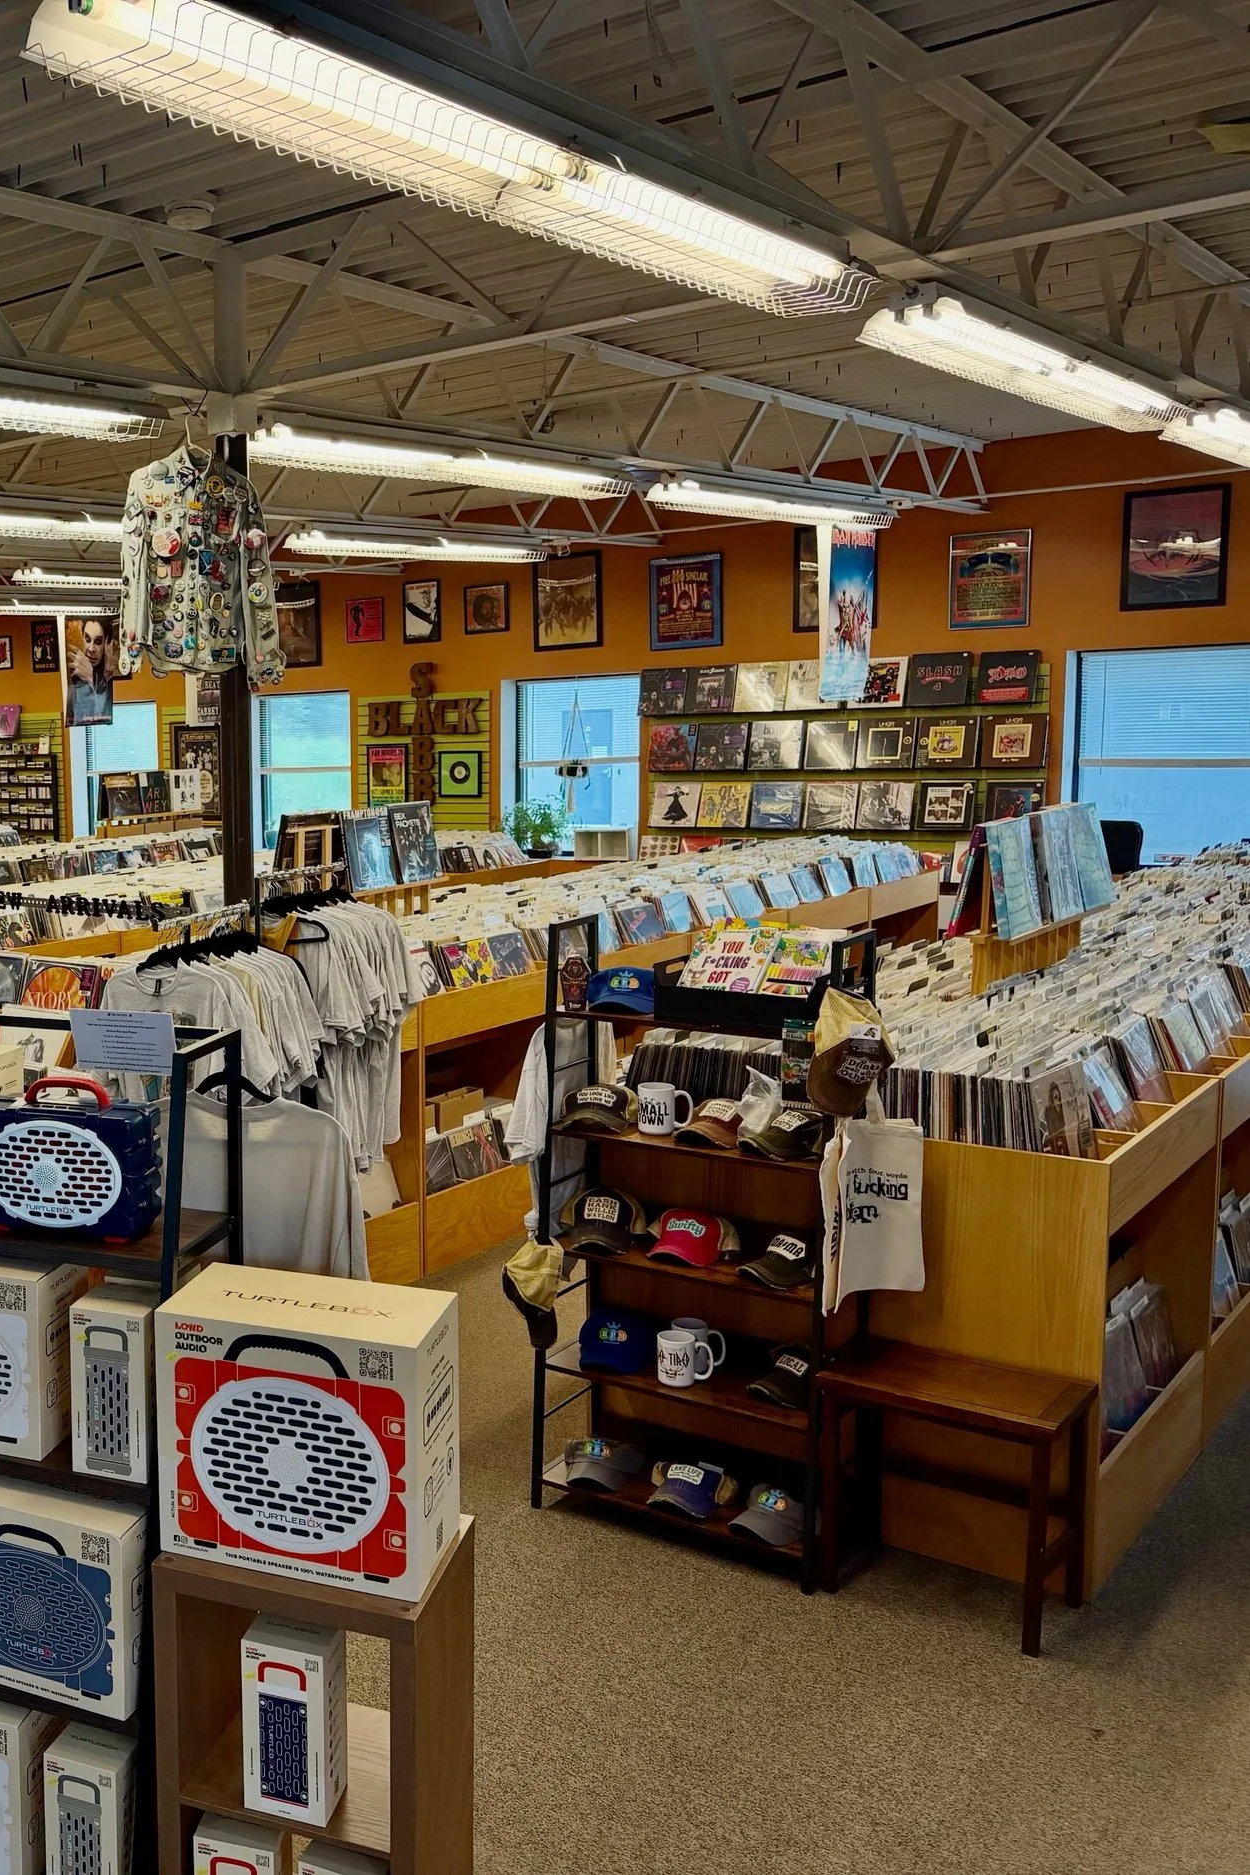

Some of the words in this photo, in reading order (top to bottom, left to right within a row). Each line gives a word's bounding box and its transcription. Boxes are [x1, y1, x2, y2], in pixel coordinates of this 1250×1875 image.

[916, 665, 963, 678] SLASH
[367, 700, 482, 737] BLACK
[45, 894, 167, 923] ARRIVALS
[721, 940, 745, 954] YOU
[707, 970, 733, 984] GOT
[853, 1174, 909, 1201] fucking
[587, 1202, 617, 1210] HANK
[589, 1197, 618, 1206] CASH
[24, 1203, 75, 1215] TURTLEBOX
[586, 1207, 616, 1215] WILLIE
[586, 1212, 615, 1221] WAYLON
[223, 1289, 394, 1319] TURTLEBOX
[174, 1331, 224, 1346] OUTDOOR
[174, 1341, 208, 1353] AUDIO
[779, 1355, 805, 1373] LOCAL
[671, 1465, 688, 1473] LAKE
[255, 1510, 323, 1529] TURTLEBOX
[225, 1552, 238, 1560] THIS
[238, 1554, 267, 1566] PORTABLE
[267, 1560, 292, 1570] SPEAKER
[299, 1566, 315, 1575] 100%
[314, 1570, 356, 1583] WATERPROOF
[4, 1638, 58, 1659] TURTLEBOX
